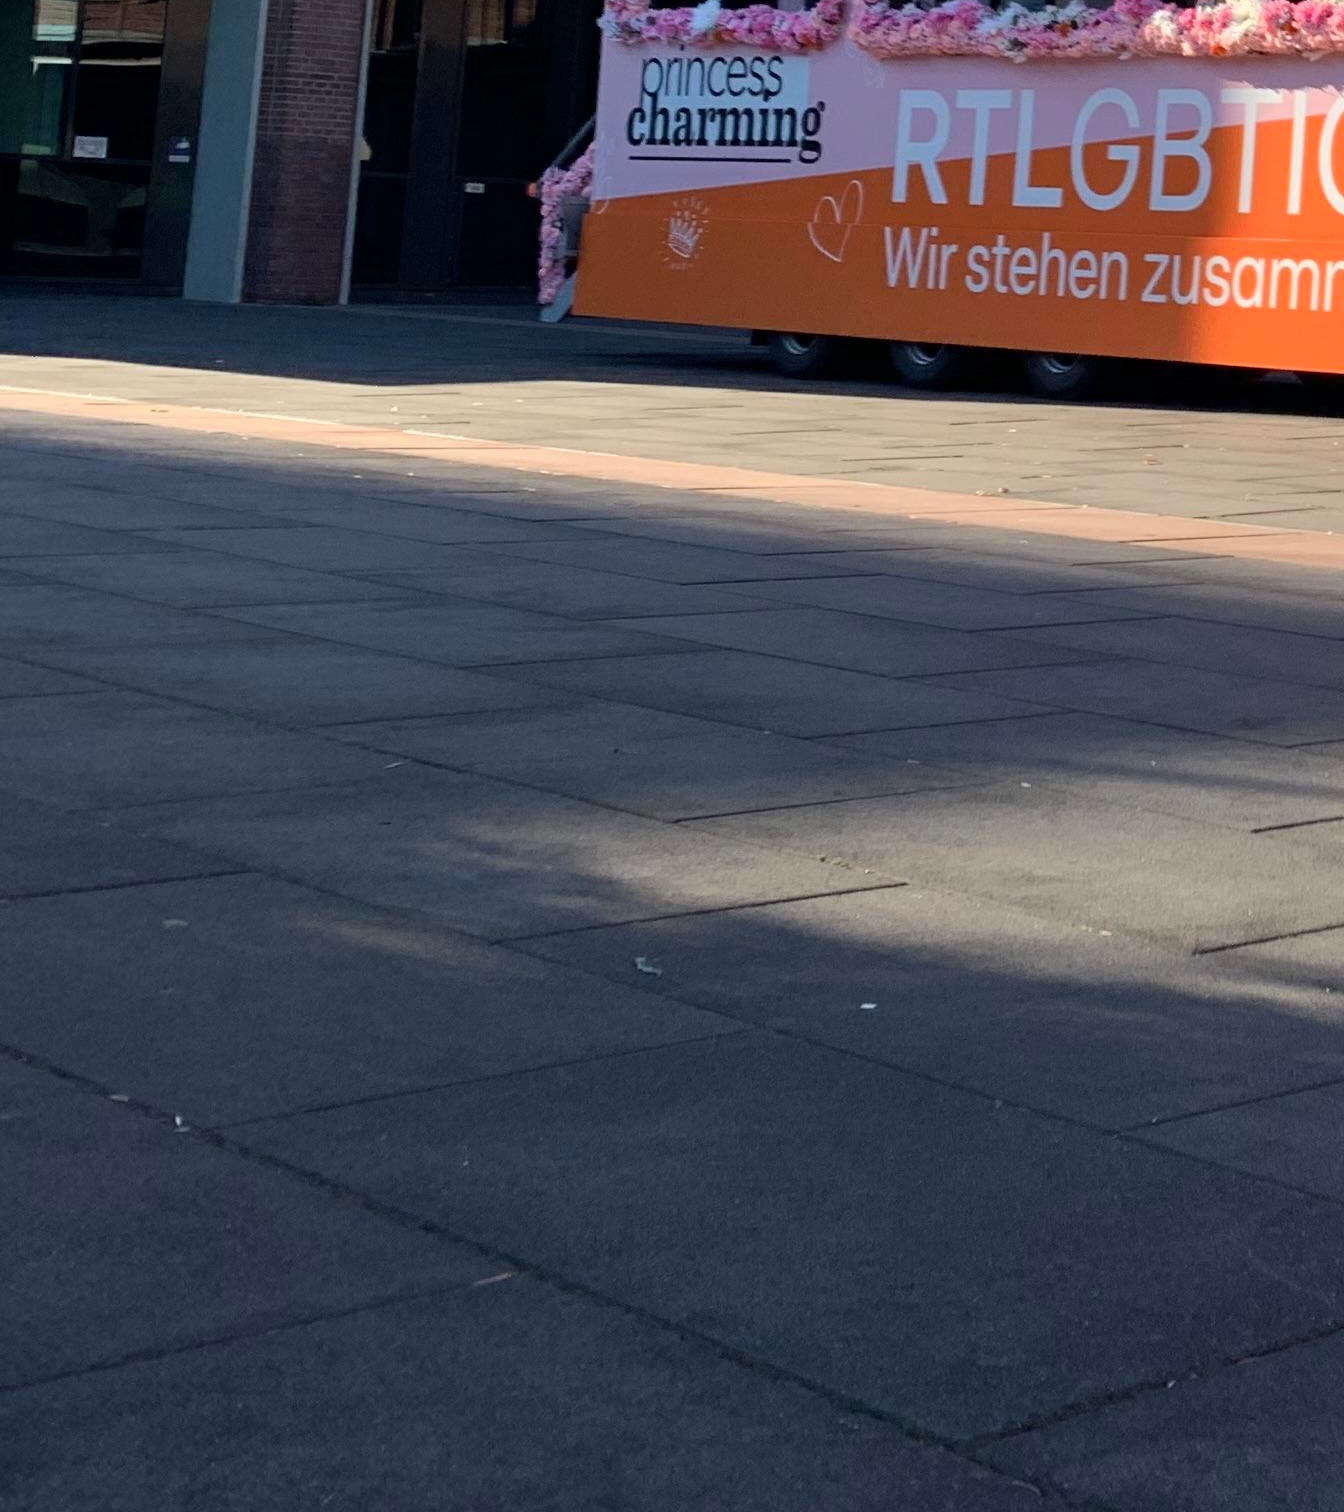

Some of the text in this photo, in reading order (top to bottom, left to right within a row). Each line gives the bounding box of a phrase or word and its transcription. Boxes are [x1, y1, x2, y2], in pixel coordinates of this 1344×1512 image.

[640, 51, 785, 106] princess
[626, 93, 826, 164] charming
[882, 226, 958, 290] Wir
[965, 233, 1129, 301] stehen
